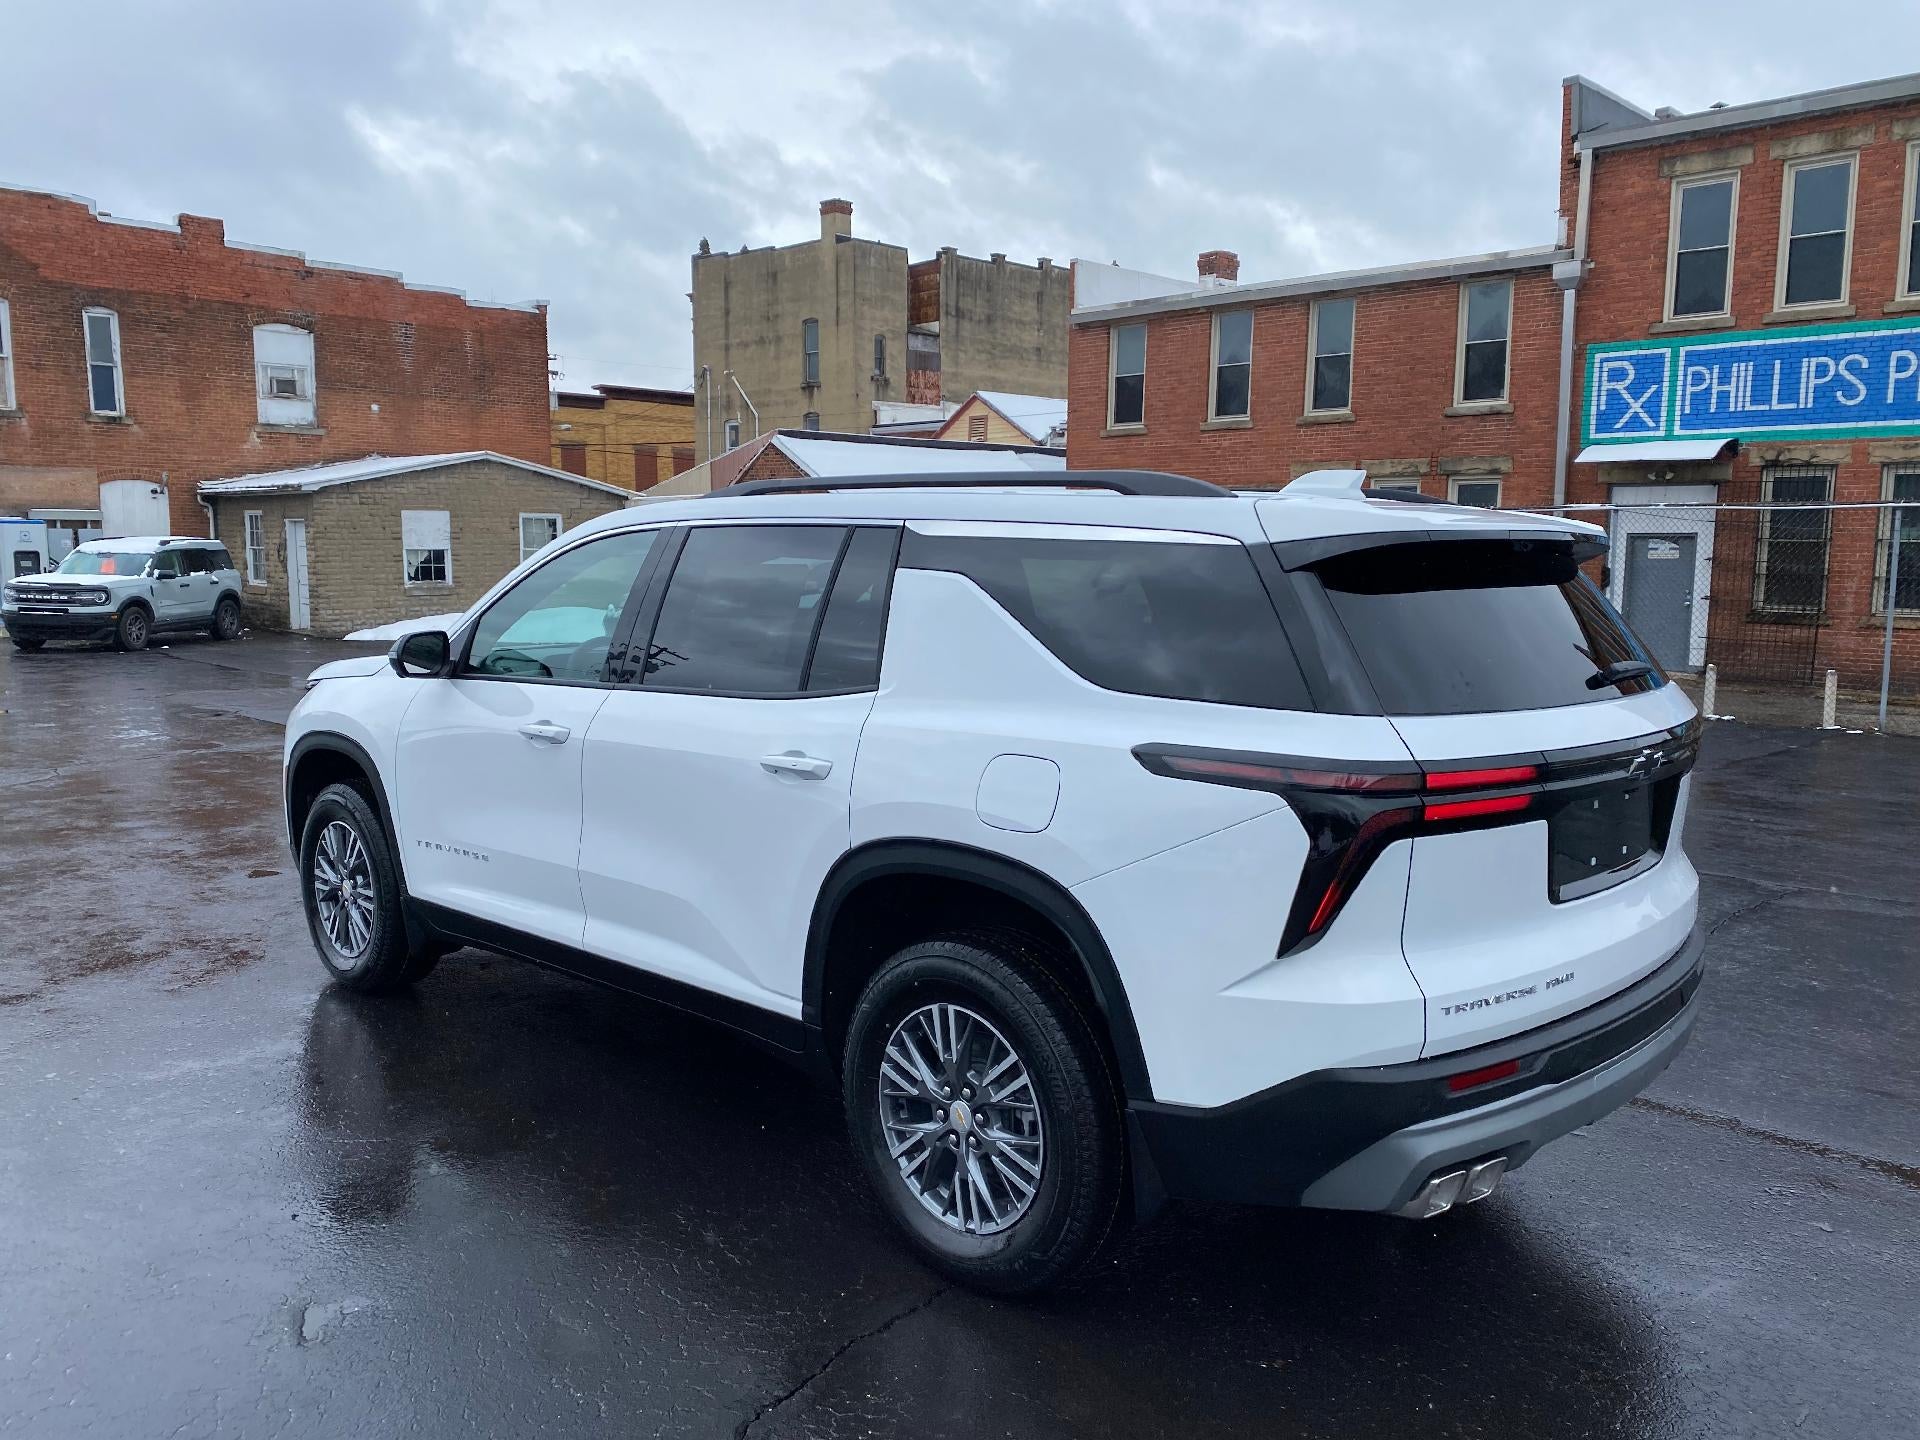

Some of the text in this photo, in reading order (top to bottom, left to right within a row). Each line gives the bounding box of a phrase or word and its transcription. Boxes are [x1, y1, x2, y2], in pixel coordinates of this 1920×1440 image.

[1684, 354, 1869, 414] PHILLIPS
[1886, 350, 1920, 403] P
[416, 840, 489, 861] TRAVERSE
[1441, 985, 1537, 1015] TRAVERSE
